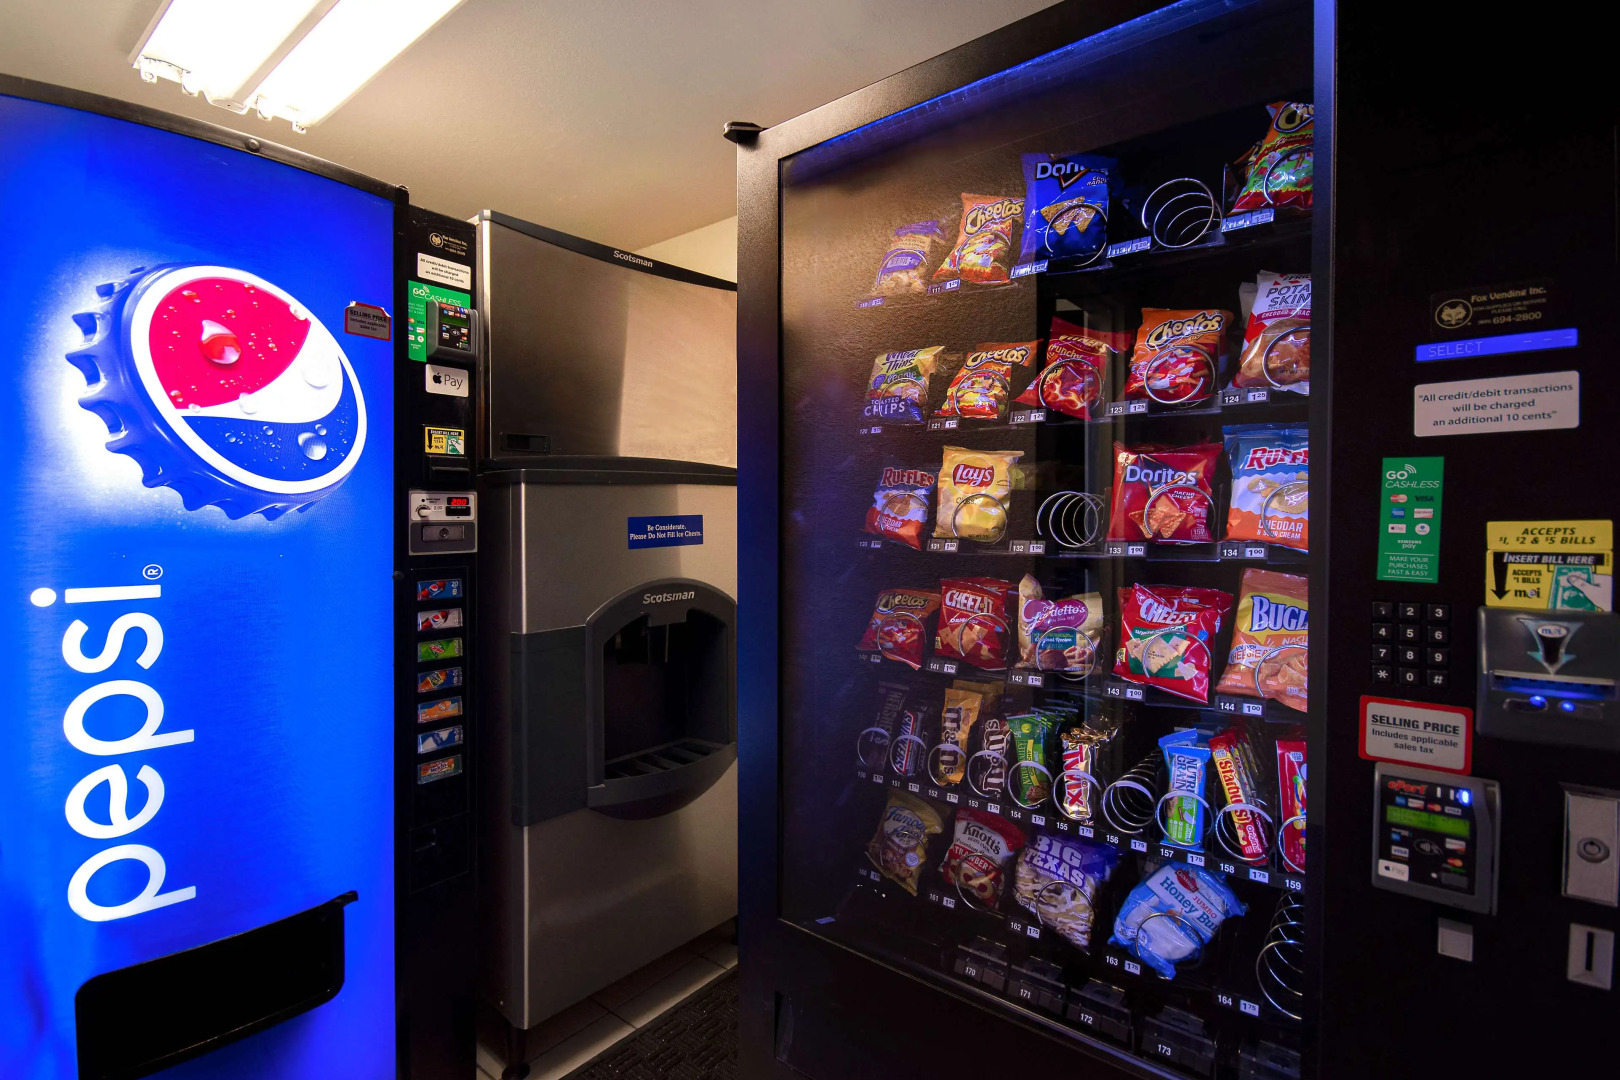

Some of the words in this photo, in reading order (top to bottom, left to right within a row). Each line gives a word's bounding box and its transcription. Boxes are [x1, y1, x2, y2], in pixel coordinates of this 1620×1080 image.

[966, 198, 1024, 235] Cheetos
[613, 250, 653, 268] Scotsman
[413, 288, 425, 296] GO
[1471, 295, 1487, 303] Fox
[1489, 288, 1526, 300] Vending
[1529, 286, 1547, 295] Inc.
[1268, 293, 1311, 307] SKIN
[1493, 311, 1542, 324] 694-2800
[1148, 311, 1223, 346] Cheetos
[1429, 341, 1483, 357] SELECT
[966, 348, 1027, 367] Cheetos
[882, 359, 915, 373] Thins
[445, 374, 463, 390] Pay
[1419, 394, 1435, 402] "All
[1438, 389, 1501, 401] credit/debit
[1504, 383, 1573, 396] transactions
[864, 402, 905, 416] CHIPS
[1452, 404, 1471, 412] will
[1473, 402, 1486, 411] be
[1490, 399, 1535, 411] charged
[1448, 414, 1502, 425] additional
[1522, 410, 1557, 420] cents"
[886, 467, 940, 487] RUFFLES
[955, 464, 992, 486] Lay's
[1126, 465, 1198, 485] Doritos
[1386, 470, 1408, 480] GO
[1522, 527, 1576, 536] ACCEPTS
[1503, 552, 1540, 563] INSERT
[1541, 554, 1564, 563] BILL
[1566, 555, 1595, 564] HERE
[642, 591, 695, 604] Scotsman
[877, 594, 928, 612] Cheetos
[1406, 607, 1414, 616] 2
[1435, 608, 1443, 617] 3
[1379, 628, 1386, 636] 4
[1406, 629, 1414, 637] 5
[1435, 630, 1443, 639] 6
[1379, 649, 1386, 657] 7
[1406, 651, 1414, 660] 8
[1435, 653, 1443, 662] 9
[1406, 672, 1414, 681] 0
[1220, 702, 1235, 711] 144
[1371, 714, 1419, 729] SELLING
[1424, 721, 1460, 734] PRICE
[1372, 728, 1409, 740] Includes
[1411, 735, 1458, 748] applicable
[30, 584, 196, 922] pepsi
[1394, 742, 1417, 751] sales
[1063, 745, 1085, 806] TWIX
[884, 806, 928, 832] Famous
[1010, 810, 1021, 818] 154
[1057, 822, 1068, 830] 155
[963, 822, 1000, 855] Knott's
[1106, 835, 1119, 843] 156
[1035, 835, 1082, 867] BIG
[1160, 848, 1173, 857] 157
[1024, 848, 1085, 887] TEXAS
[1220, 863, 1235, 873] 158
[1285, 879, 1301, 890] 159
[1160, 876, 1199, 915] Honey
[1193, 896, 1217, 918] JUMBO
[1010, 922, 1022, 930] 162
[1105, 956, 1118, 966] 163
[965, 966, 977, 976] 170
[1020, 989, 1031, 999] 171
[1217, 994, 1233, 1006] 164
[1080, 1013, 1093, 1024] 172
[1157, 1044, 1172, 1055] 173
